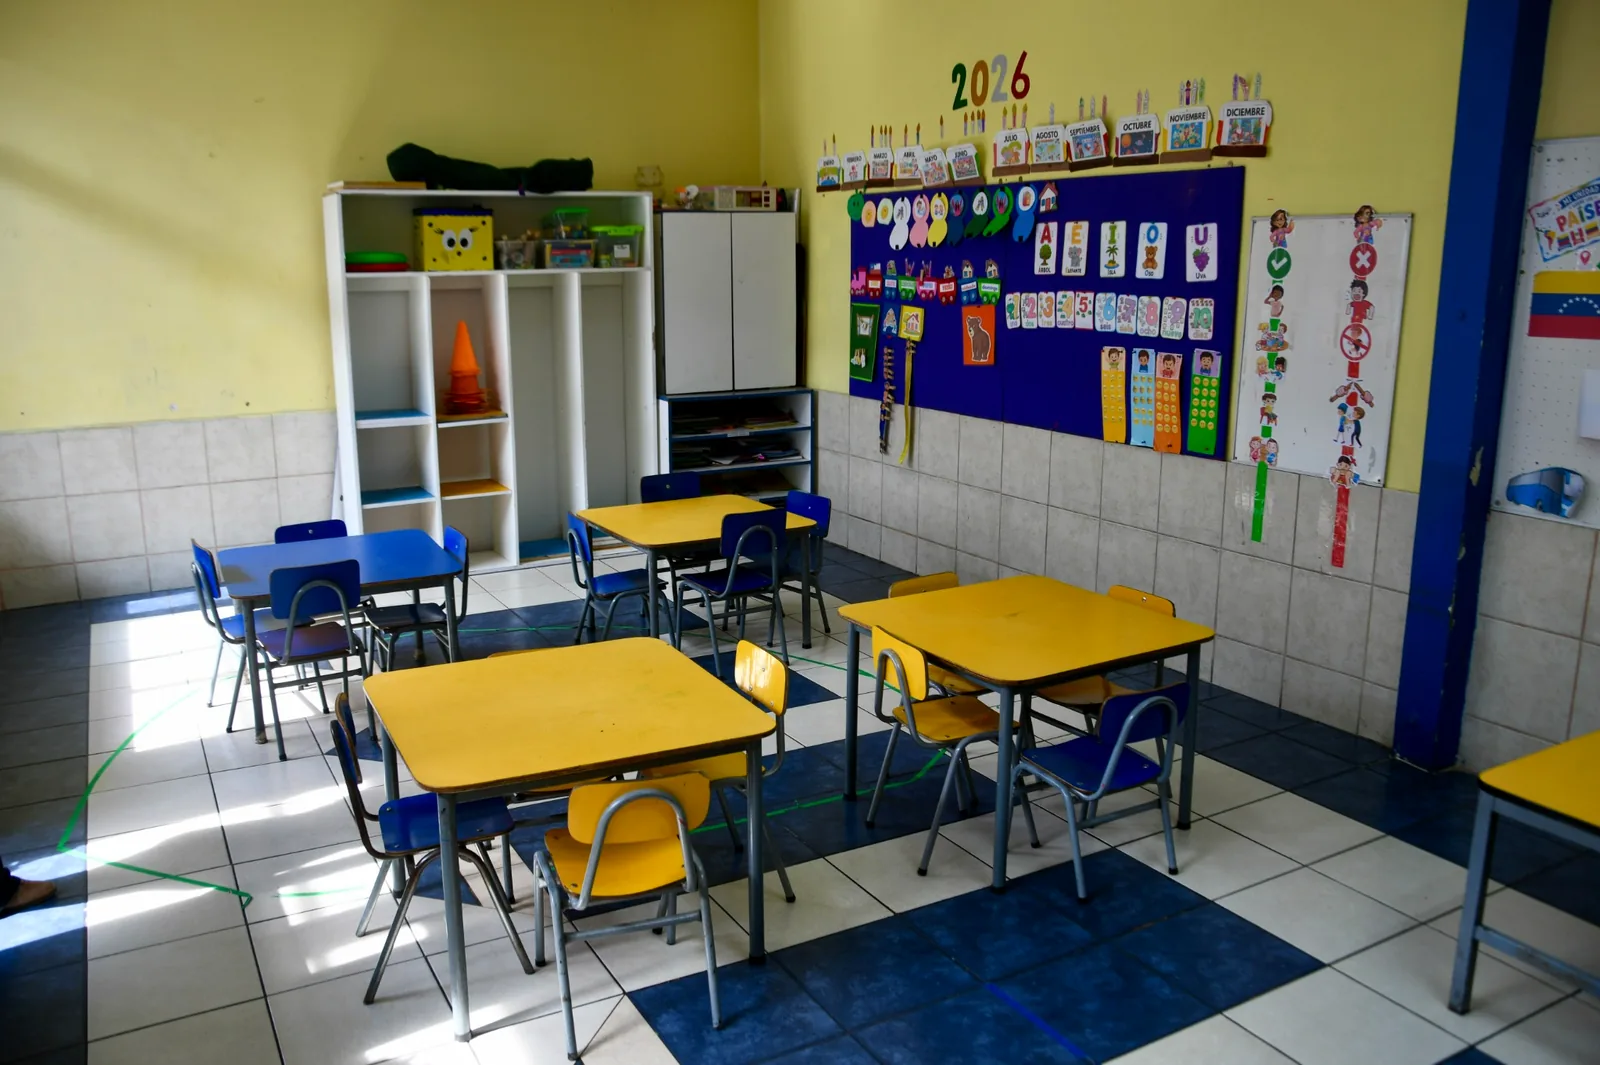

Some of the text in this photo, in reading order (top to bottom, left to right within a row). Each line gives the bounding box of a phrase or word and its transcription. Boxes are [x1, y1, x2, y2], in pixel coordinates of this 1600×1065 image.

[952, 50, 1030, 110] 2026
[1169, 112, 1206, 123] NOVIEMBRE
[1226, 107, 1266, 117] DICIEMBRE
[1036, 131, 1059, 140] AGOSTO
[1069, 125, 1101, 137] SEPTIEMBRE
[1123, 121, 1152, 131] OCTUBRE
[1003, 134, 1018, 143] JULIO
[846, 155, 863, 163] RERO
[873, 152, 888, 160] MARZO
[924, 154, 938, 163] MAYO
[1040, 223, 1052, 244] A
[1071, 224, 1083, 245] E
[1108, 225, 1117, 245] I
[1146, 225, 1159, 244] O
[1194, 226, 1208, 246] U
[1027, 297, 1037, 319] 2
[1043, 296, 1054, 318] 3
[1062, 296, 1073, 319] 4
[1079, 296, 1088, 313] 5
[1103, 297, 1115, 321] 6
[1124, 298, 1136, 321] 7
[1145, 301, 1158, 326] 8
[1170, 300, 1186, 324] 9
[1193, 307, 1212, 330] 10
[1140, 326, 1157, 336] ocho
